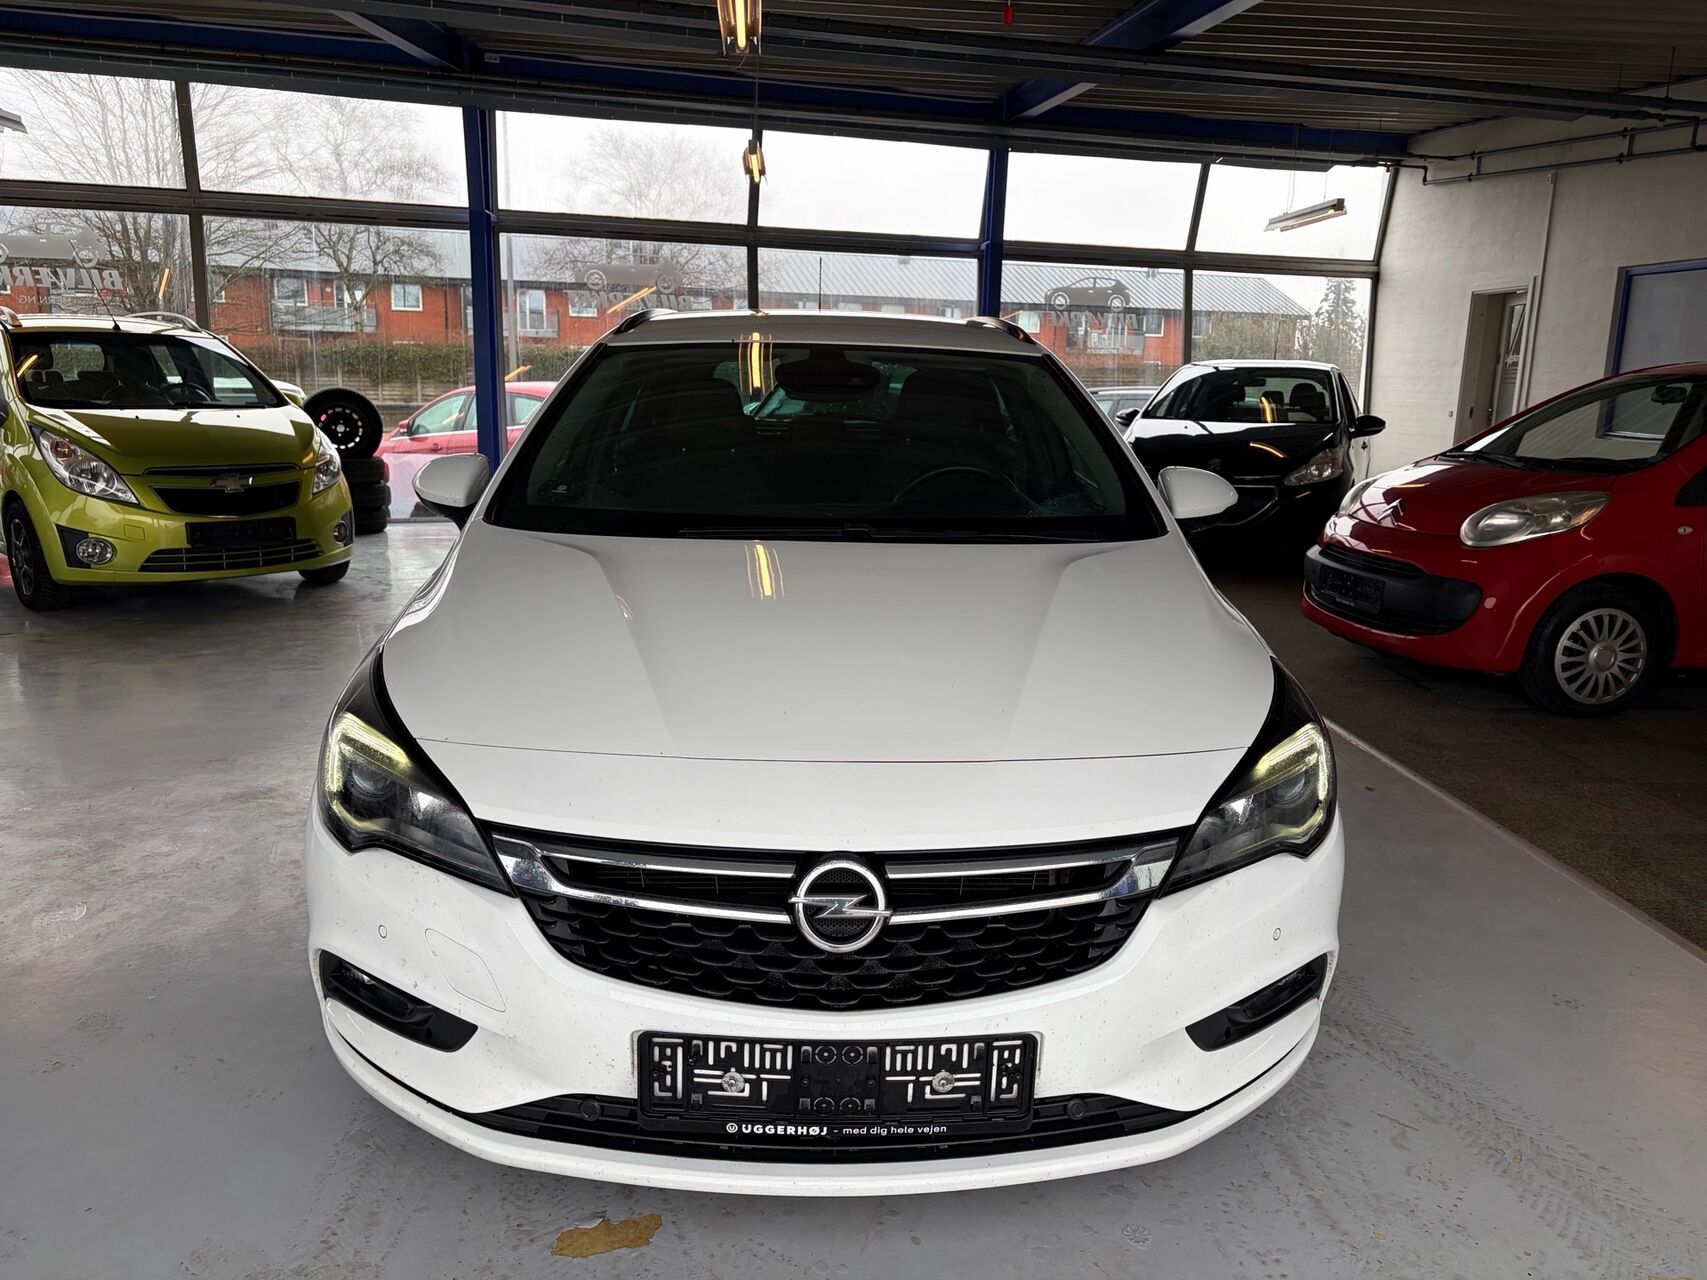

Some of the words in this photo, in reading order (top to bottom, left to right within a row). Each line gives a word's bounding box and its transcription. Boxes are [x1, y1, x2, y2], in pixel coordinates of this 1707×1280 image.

[742, 1124, 828, 1136] UGGERHØJ
[843, 1126, 867, 1135] med
[870, 1126, 888, 1136] dig
[891, 1126, 915, 1134] hele
[918, 1125, 947, 1135] vejen
